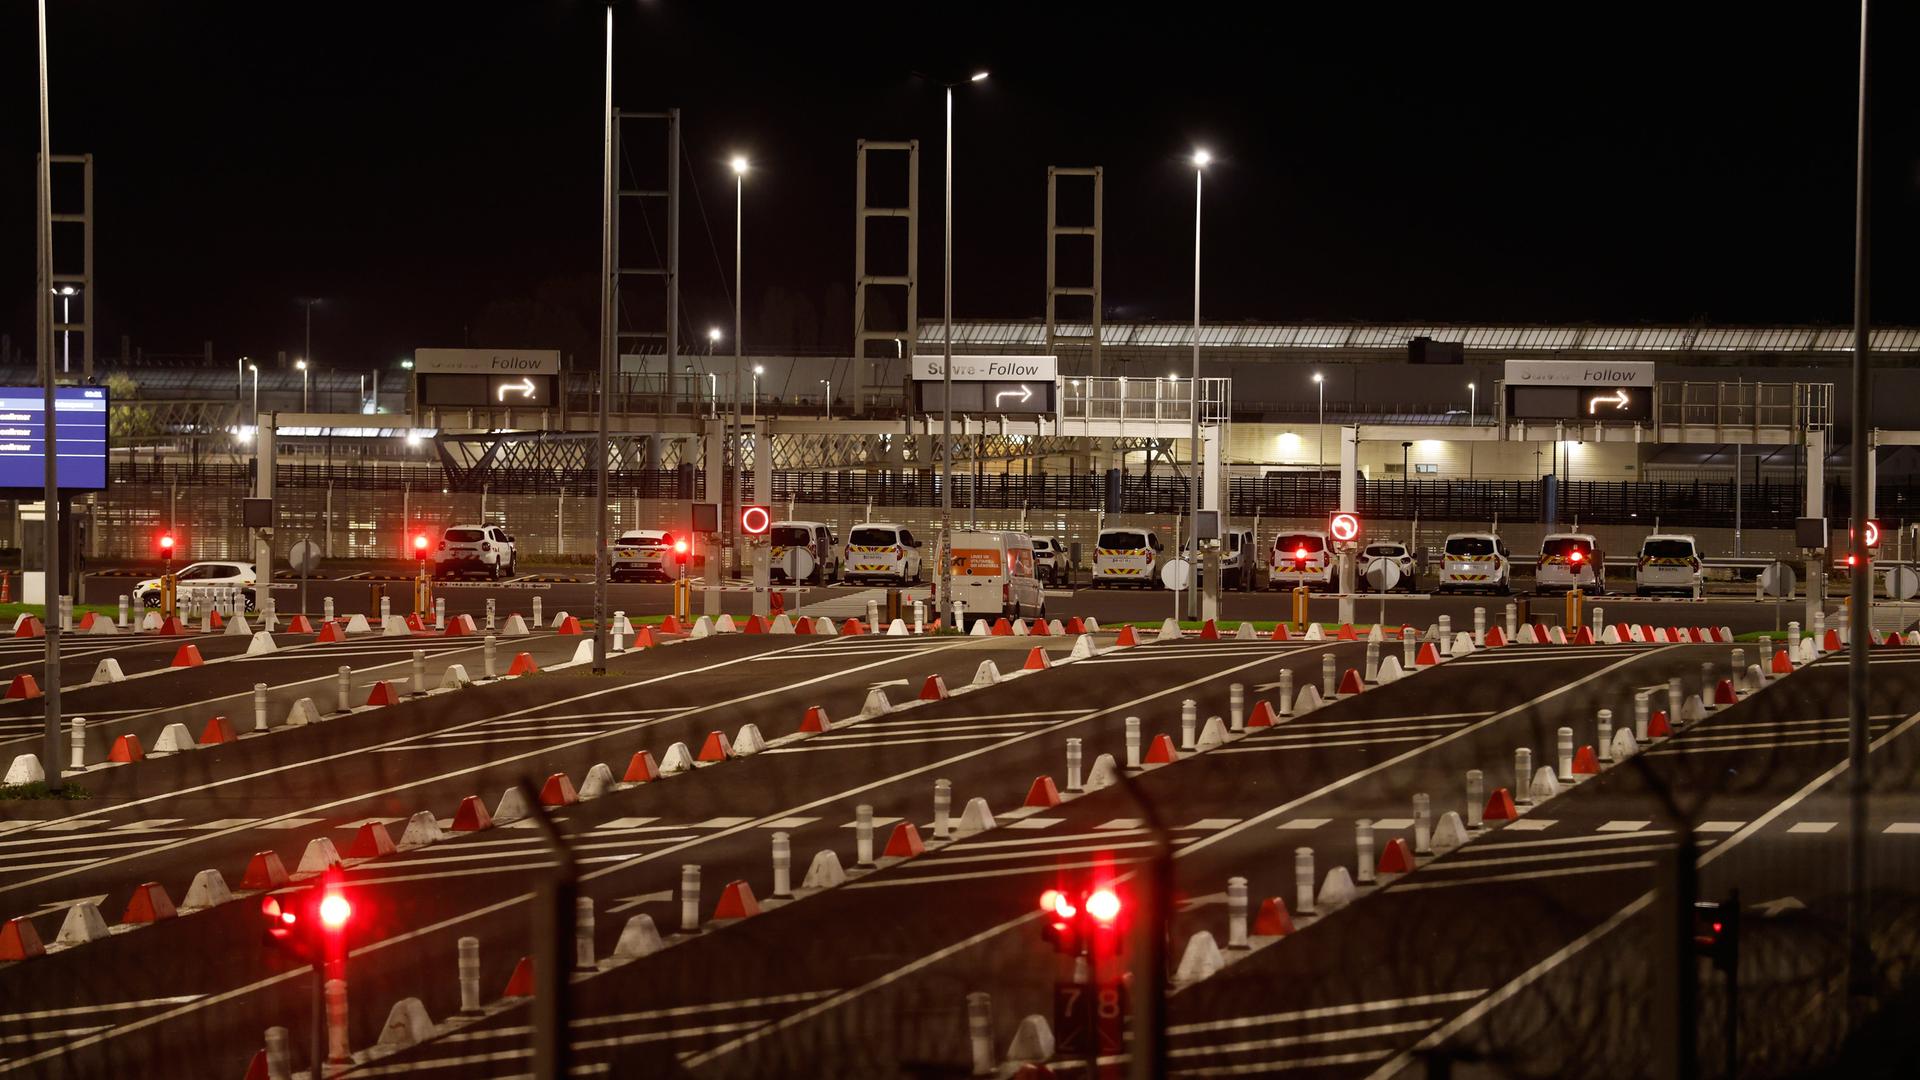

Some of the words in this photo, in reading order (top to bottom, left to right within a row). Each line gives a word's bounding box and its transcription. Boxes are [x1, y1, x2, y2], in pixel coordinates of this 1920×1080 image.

[491, 356, 541, 369] Follow
[928, 362, 975, 375] Suvre
[988, 363, 1039, 375] Follow
[1583, 370, 1636, 381] Follow
[1060, 988, 1081, 1017] 7
[1097, 989, 1119, 1018] 8
